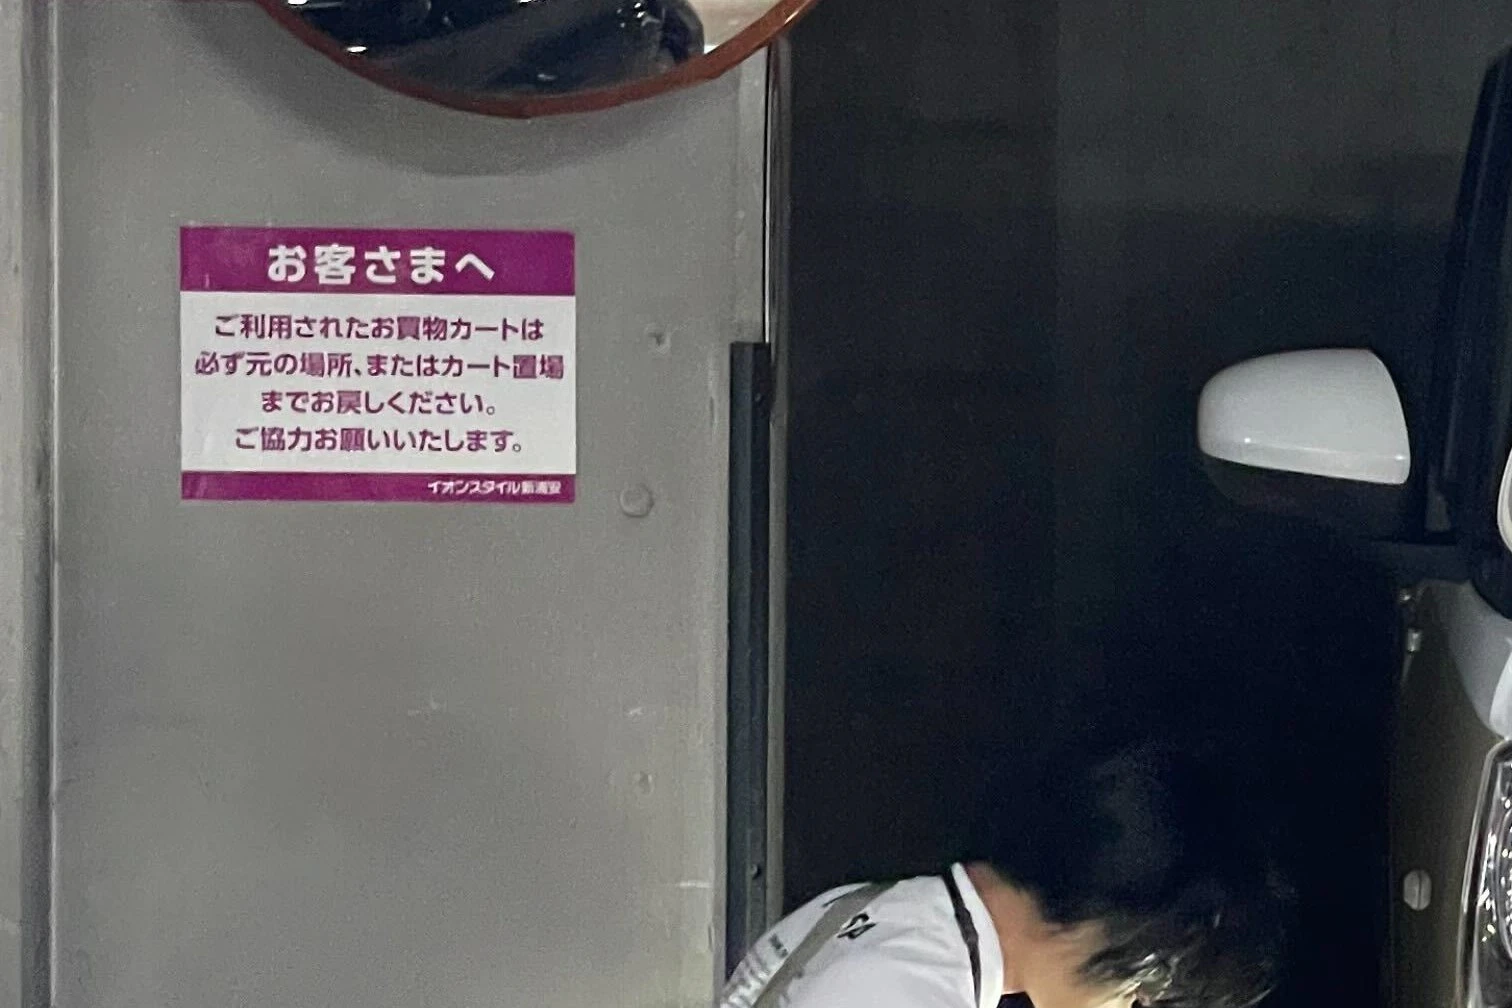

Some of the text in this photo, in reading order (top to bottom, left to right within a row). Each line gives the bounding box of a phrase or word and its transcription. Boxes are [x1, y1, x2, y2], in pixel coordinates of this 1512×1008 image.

[267, 244, 496, 285] お客さまへ
[214, 314, 545, 341] ご利用されたお買物カートは
[194, 352, 565, 379] 必ず元の場所、またはカート置場
[261, 390, 497, 415] までお戻しください。
[234, 426, 523, 453] ご協力お願いいたします。
